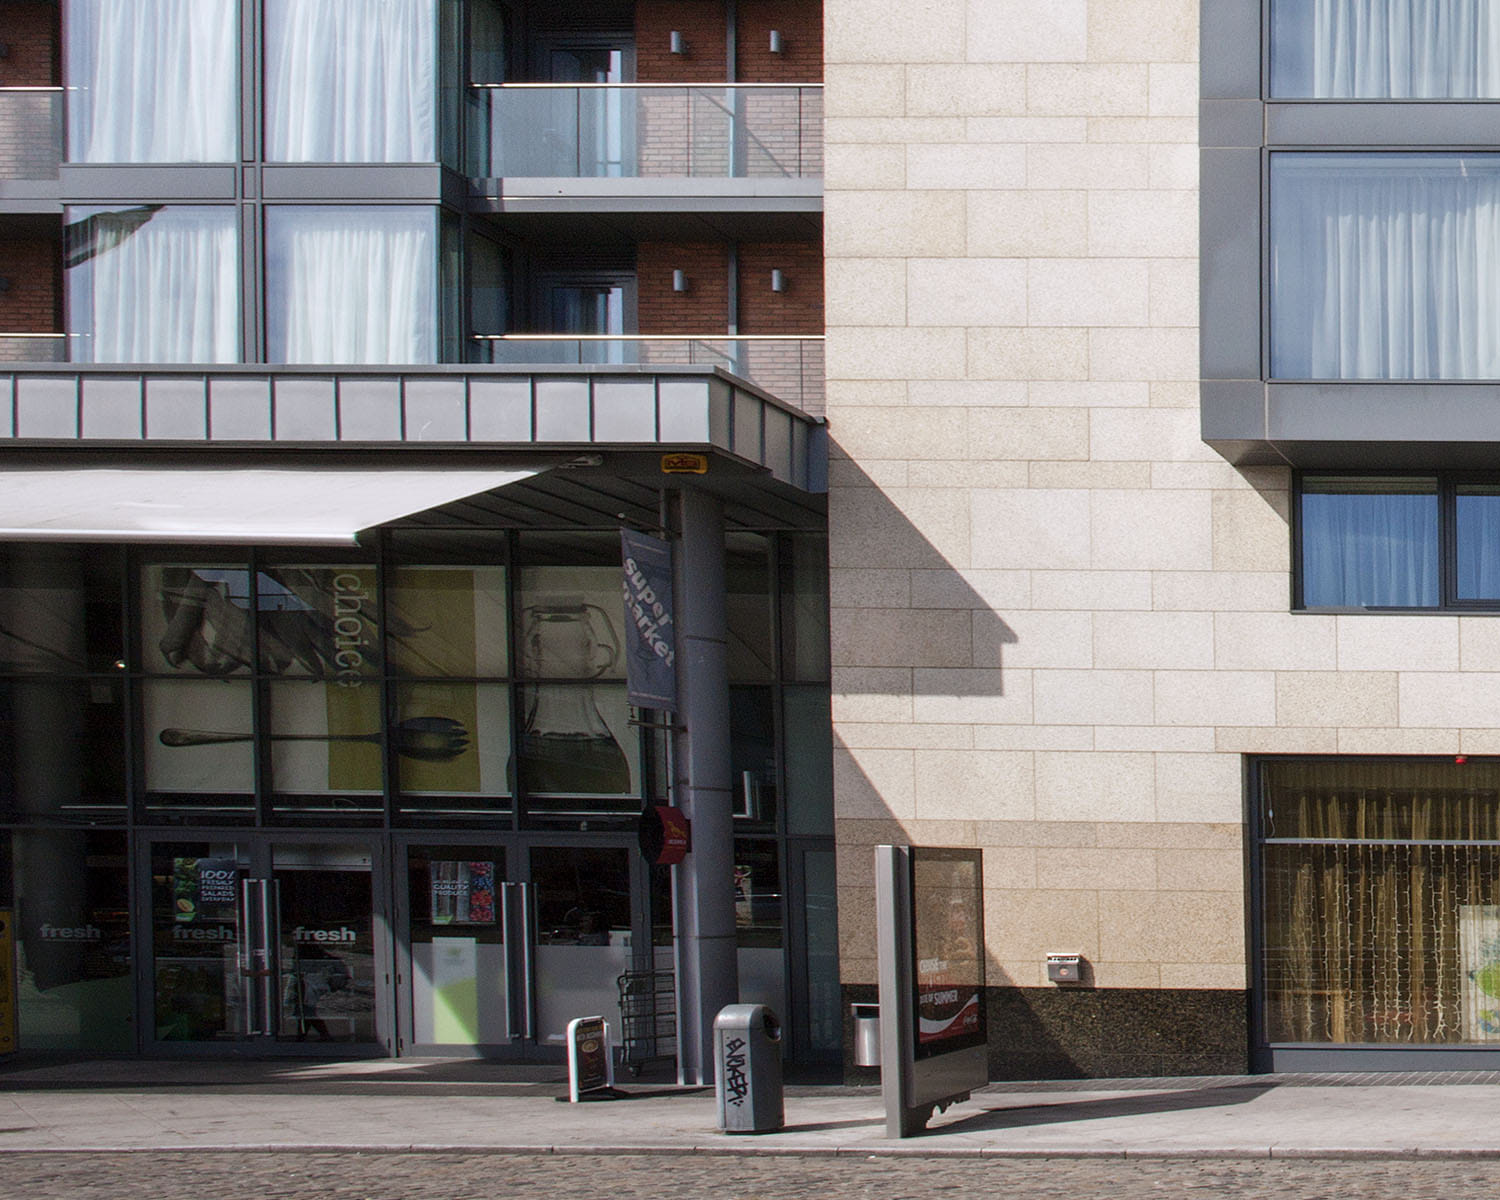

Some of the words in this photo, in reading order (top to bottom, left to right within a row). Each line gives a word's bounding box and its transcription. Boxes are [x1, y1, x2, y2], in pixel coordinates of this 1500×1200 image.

[624, 557, 673, 627] super
[333, 573, 369, 688] choice
[40, 923, 101, 938] fresh
[172, 924, 233, 939] fresh
[293, 925, 356, 941] fresh
